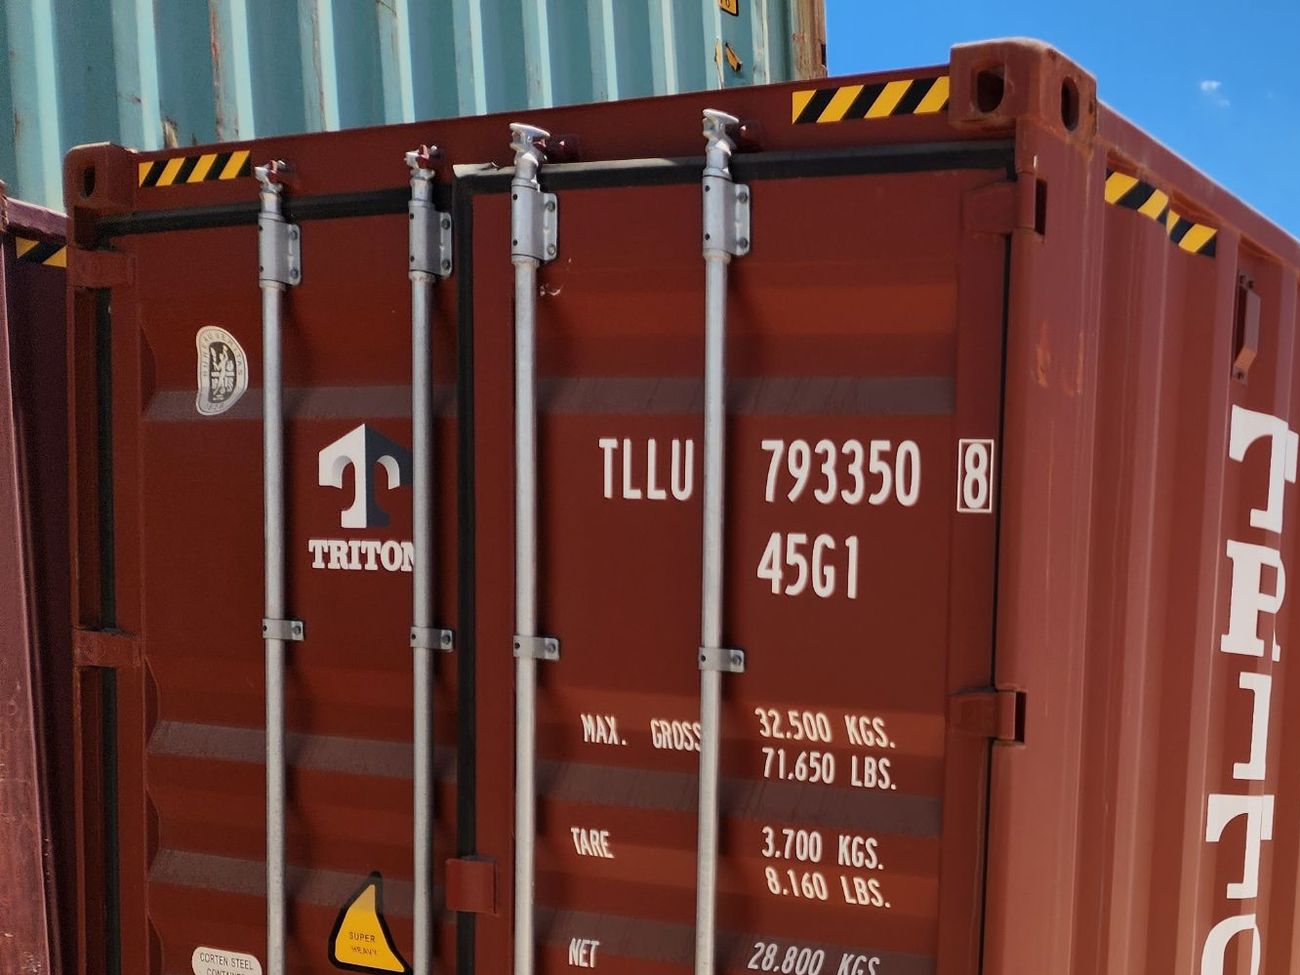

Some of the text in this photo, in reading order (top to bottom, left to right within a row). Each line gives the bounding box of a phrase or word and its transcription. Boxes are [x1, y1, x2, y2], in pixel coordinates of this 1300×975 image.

[599, 438, 990, 511] TLLU 793350 8
[756, 532, 859, 600] 45G1
[580, 707, 896, 753] MAX. GROSS 32.500 KGS.
[761, 747, 897, 791] 71.650 LBS.
[570, 826, 884, 871] TARE 3.700 KGS.
[764, 866, 892, 909] 8.160 LBS.
[348, 931, 377, 943] SUPER
[568, 937, 601, 969] NET
[199, 952, 254, 971] CORTEN STEEL
